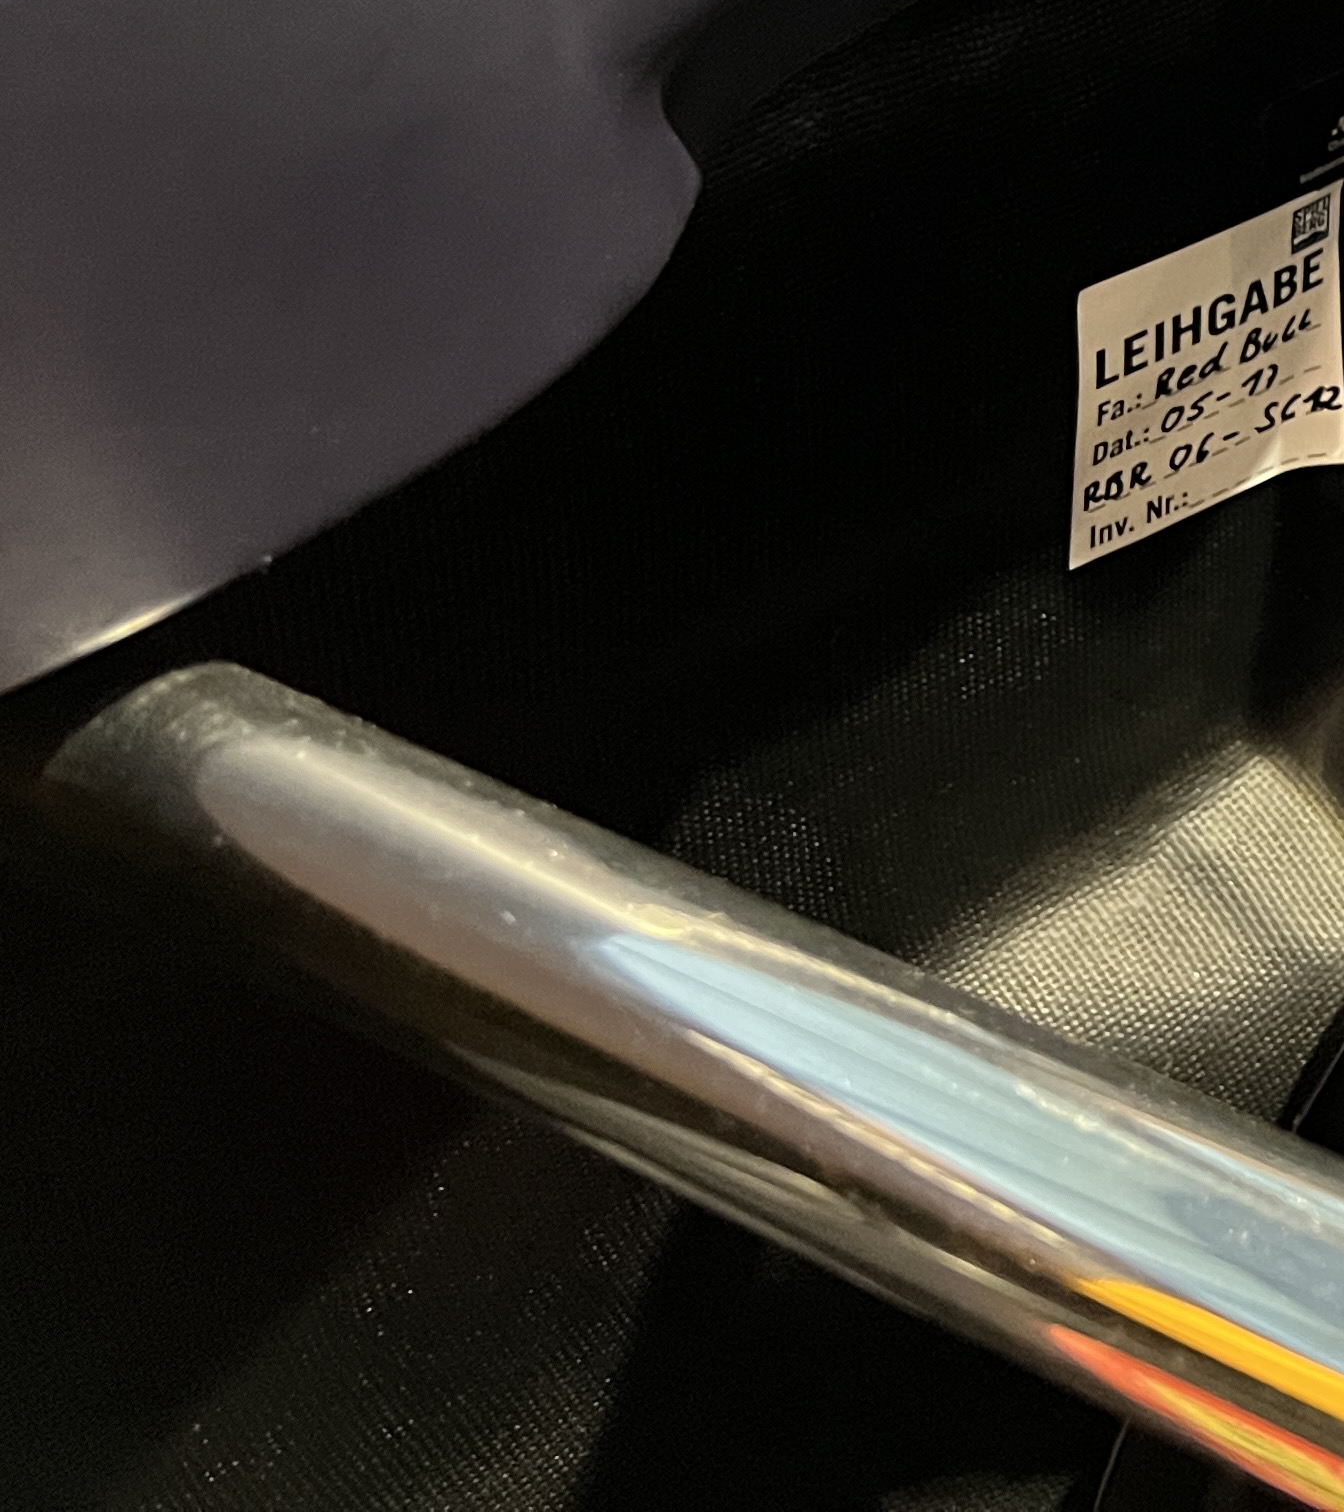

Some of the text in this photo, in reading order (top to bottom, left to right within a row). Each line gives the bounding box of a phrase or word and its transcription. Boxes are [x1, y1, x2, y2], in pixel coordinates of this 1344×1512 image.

[1095, 248, 1324, 389] LEIHGABE
[1096, 308, 1312, 427] Fa.: Red Bull
[1091, 427, 1151, 467] Dat.:
[1089, 490, 1189, 549] Inv. Nr.:
